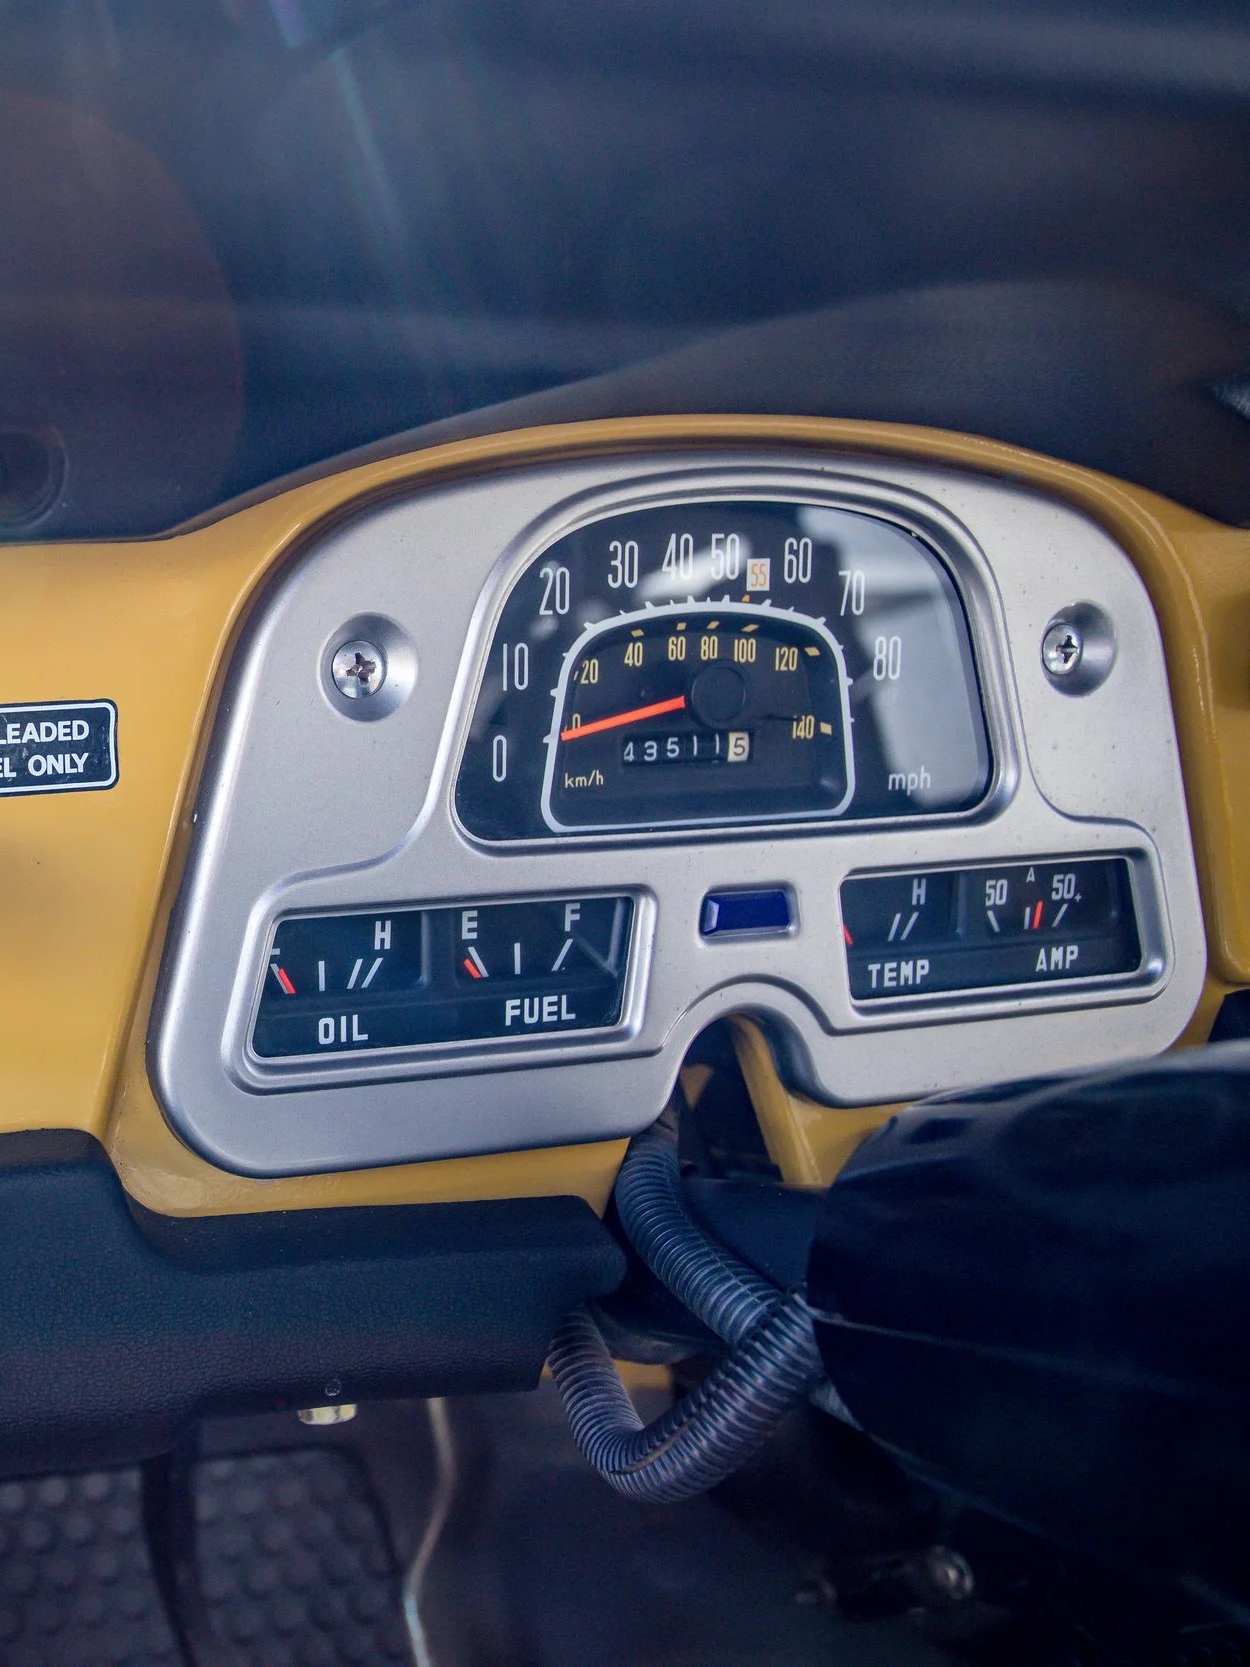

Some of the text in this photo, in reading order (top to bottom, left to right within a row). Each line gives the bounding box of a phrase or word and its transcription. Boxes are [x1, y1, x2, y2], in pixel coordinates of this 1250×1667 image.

[502, 533, 901, 691] 10 20 30 40 50 55 60 70 80
[580, 659, 599, 684] 20
[624, 642, 643, 667] 40
[668, 636, 686, 661] 60
[701, 636, 718, 661] 80
[734, 638, 756, 663] 100
[775, 647, 798, 672] 120
[28, 752, 90, 777] ONLY
[493, 735, 507, 782] 0
[564, 769, 604, 788] km/h
[888, 766, 931, 796] mph
[912, 878, 927, 906] H
[985, 879, 1008, 907] 50
[374, 920, 392, 950] H
[461, 902, 581, 940] E F
[1036, 945, 1079, 972] AMP
[867, 959, 930, 989] TEMP
[505, 994, 576, 1026] FUEL
[318, 1014, 369, 1045] OIL
